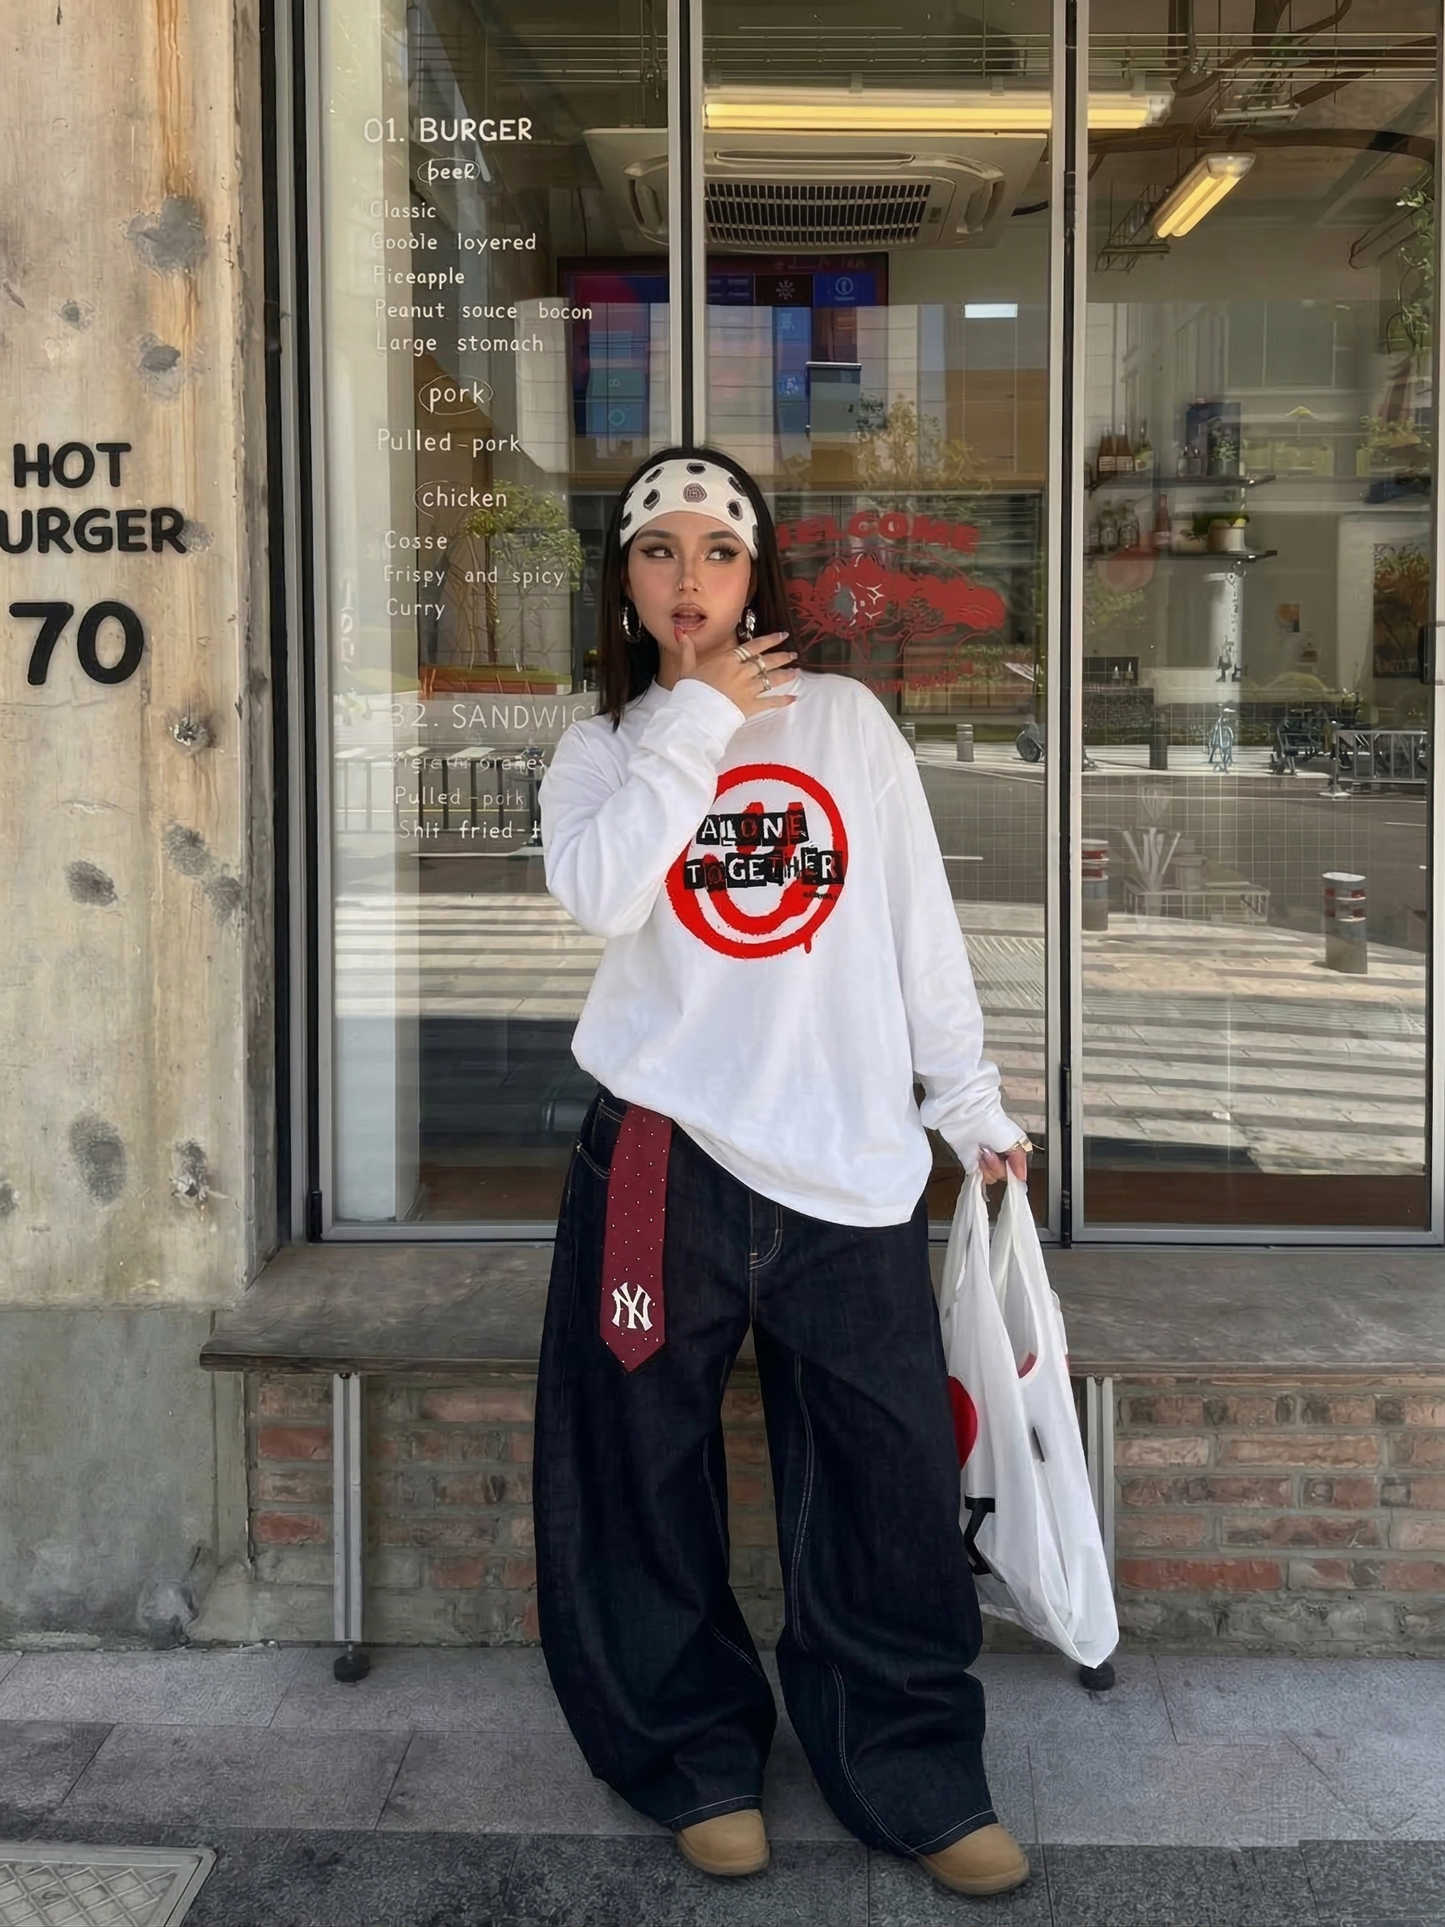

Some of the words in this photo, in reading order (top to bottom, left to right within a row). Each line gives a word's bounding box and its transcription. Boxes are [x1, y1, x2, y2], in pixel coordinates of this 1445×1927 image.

[364, 117, 405, 143] 01.
[419, 116, 533, 142] BURGER
[370, 200, 437, 218] Classic
[374, 298, 446, 319] Peanut
[461, 304, 518, 319] souce
[538, 301, 593, 320] bocon
[375, 326, 437, 358] Large
[457, 333, 544, 353] stomach
[428, 381, 485, 414] pork
[13, 441, 132, 489] HOT
[422, 486, 507, 508] chicken
[384, 530, 448, 550] Cosse
[464, 566, 499, 583] and
[511, 568, 564, 589] spicy
[386, 597, 446, 621] Curry
[8, 600, 145, 686] 70
[698, 811, 809, 845] ALONE
[684, 848, 844, 891] TOGETHER
[611, 1281, 654, 1332] NY
